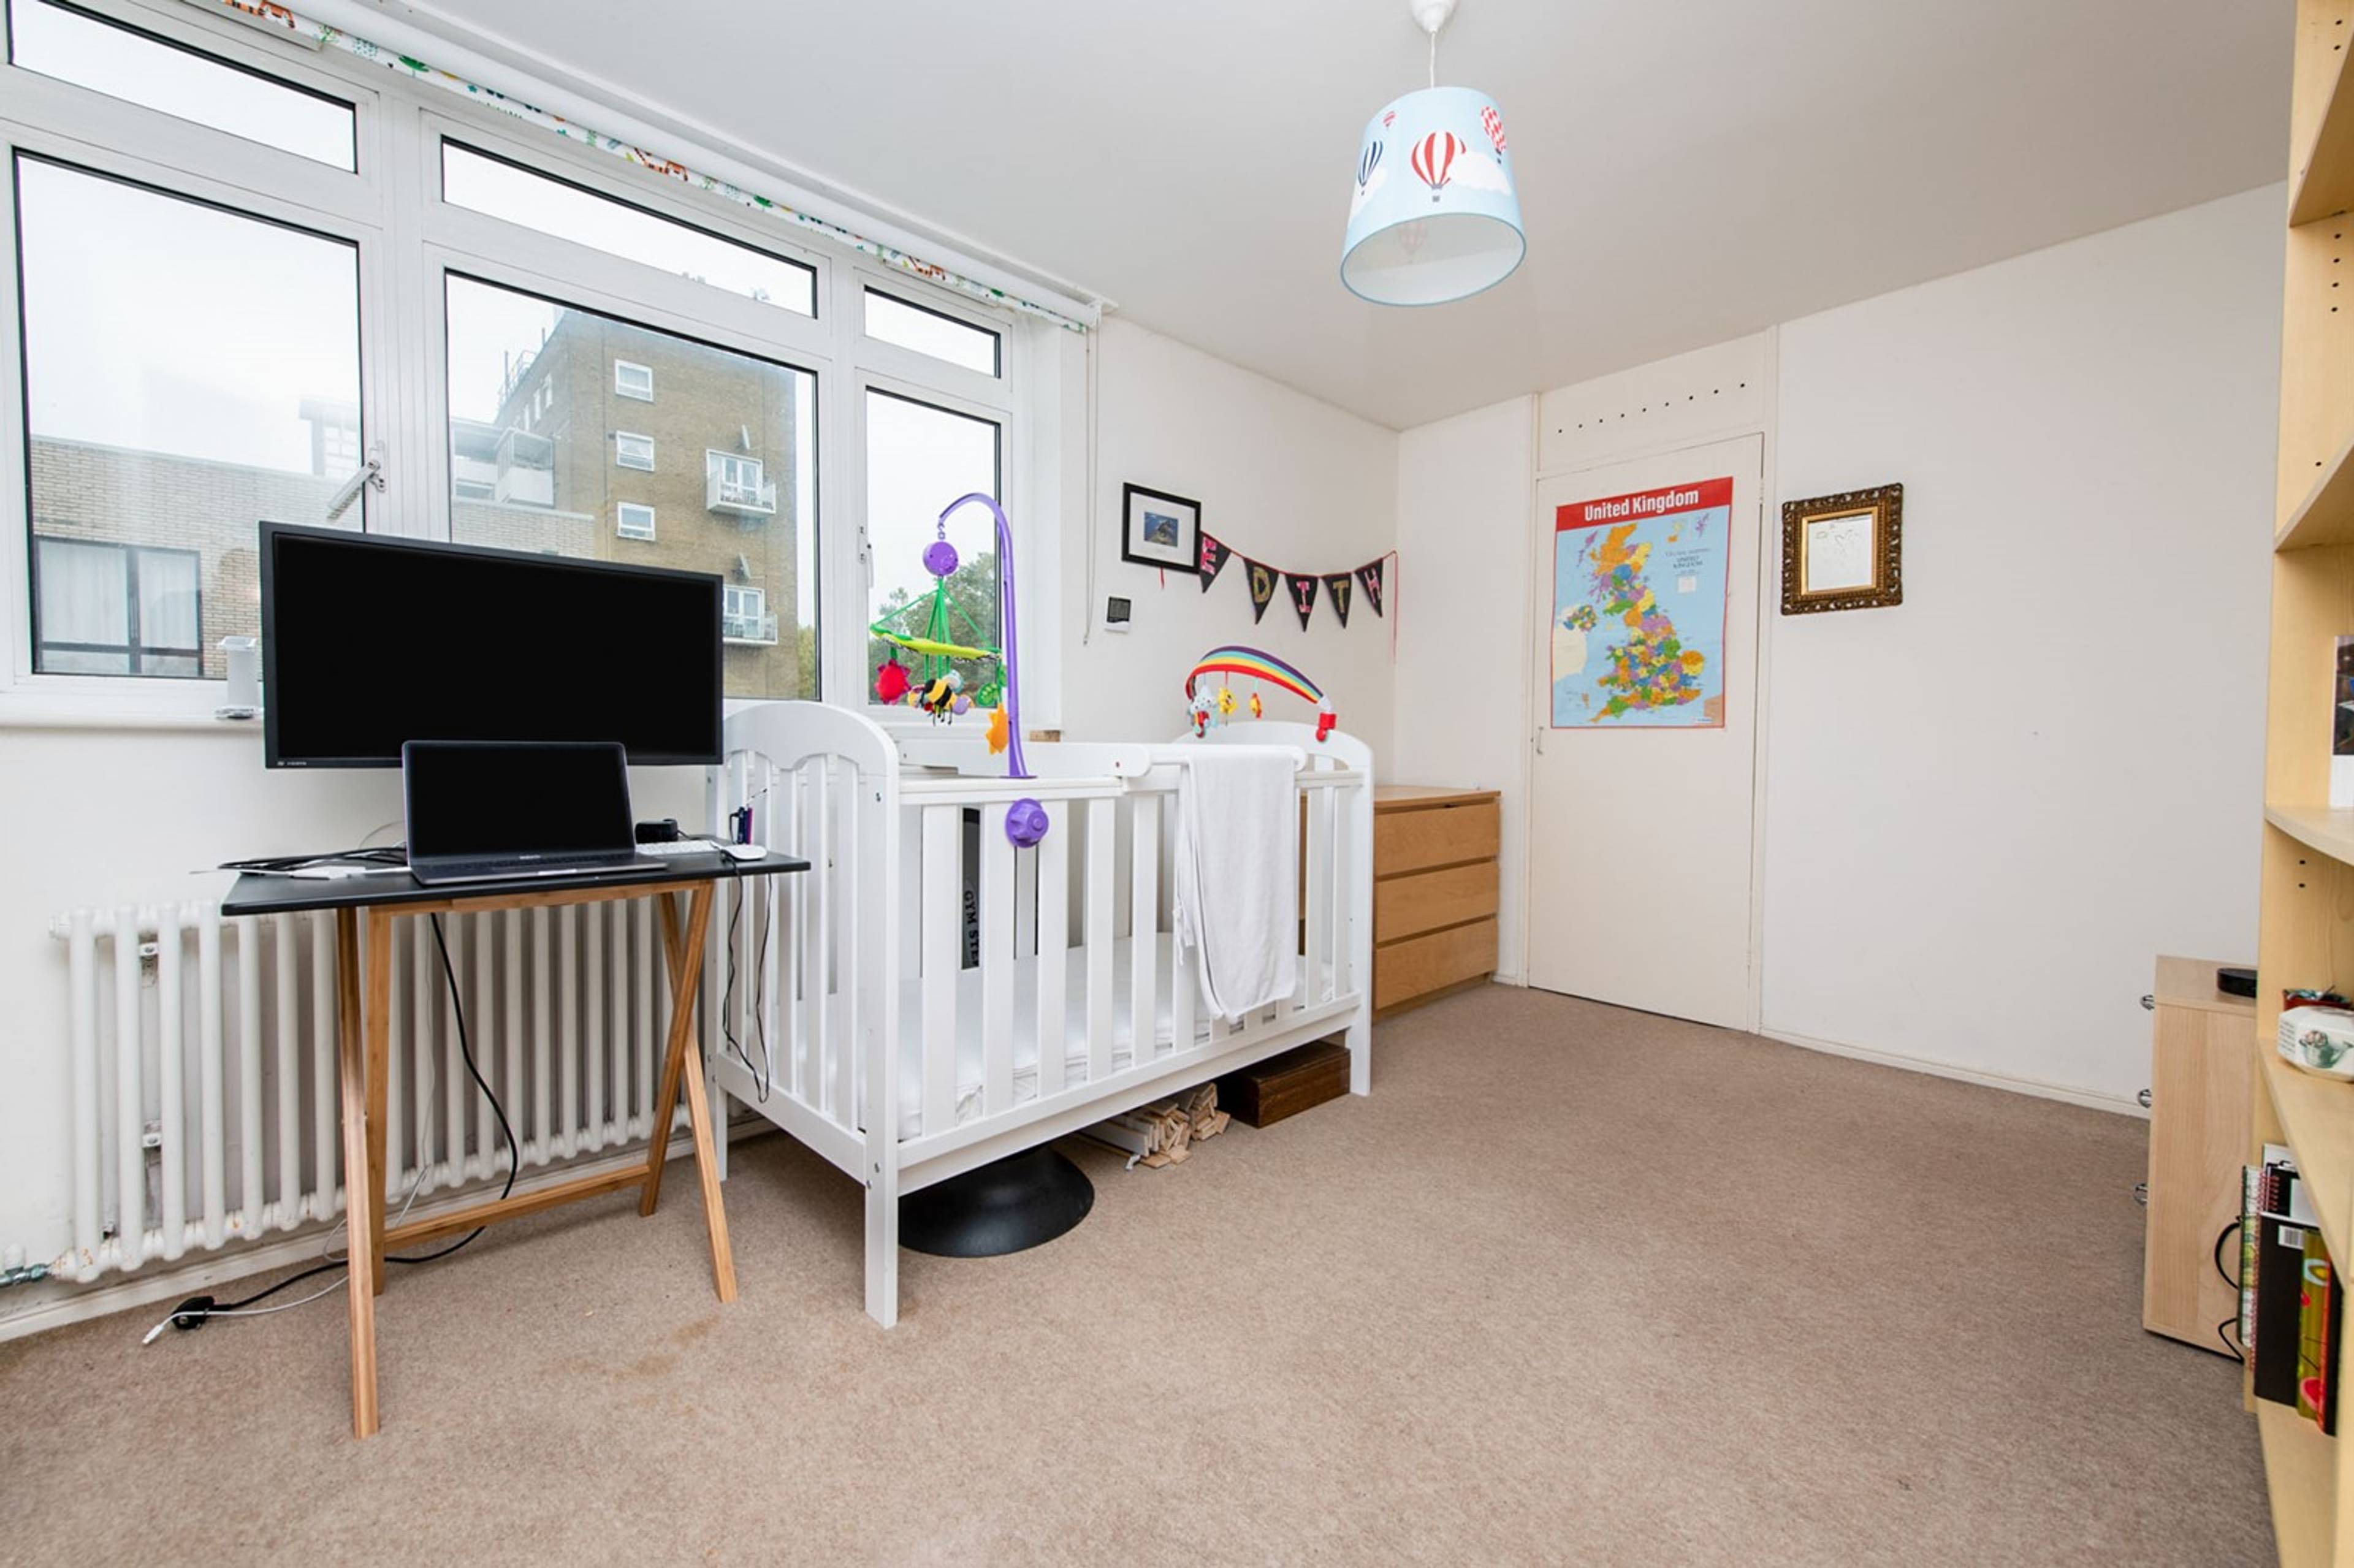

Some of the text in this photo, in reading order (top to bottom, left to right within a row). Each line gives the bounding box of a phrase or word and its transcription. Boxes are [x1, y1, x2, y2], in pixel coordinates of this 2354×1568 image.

[1585, 490, 1699, 521] United Kingdom
[1200, 536, 1382, 614] EDITH
[964, 890, 977, 924] GYM
